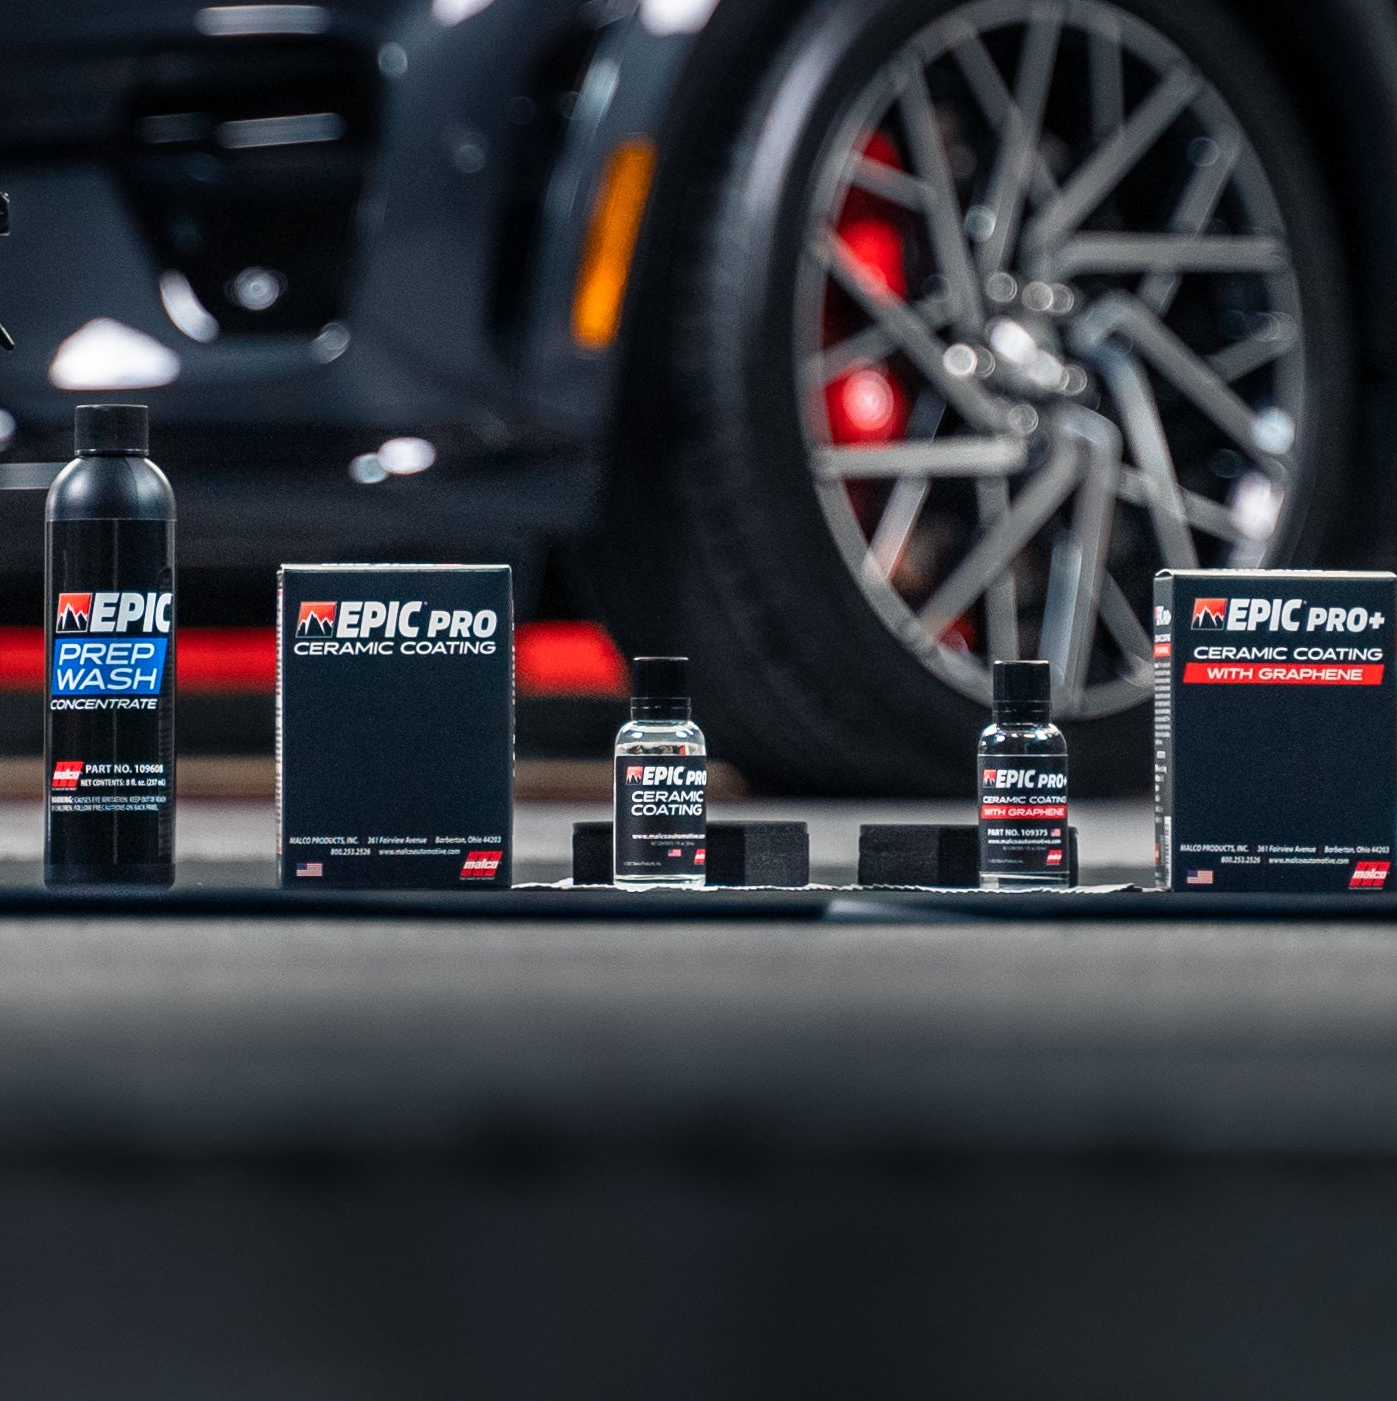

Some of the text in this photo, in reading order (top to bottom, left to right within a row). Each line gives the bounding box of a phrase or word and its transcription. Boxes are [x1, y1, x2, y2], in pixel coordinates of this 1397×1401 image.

[90, 593, 171, 632] EPIC
[1227, 598, 1385, 632] EPIC PRO+
[336, 601, 497, 638] EPIC PRO
[59, 643, 154, 665] PREP
[294, 642, 496, 655] CERAMIC COATING
[1194, 647, 1383, 661] CERAMIC COATING
[57, 668, 157, 690] WASH
[1207, 668, 1363, 680] WITH GRAPHENE
[50, 699, 157, 710] CONCENTRATE
[86, 765, 111, 773] PART
[114, 765, 132, 773] NO.
[643, 766, 707, 785] EPIC PRO
[996, 770, 1036, 788] EPIC
[632, 791, 704, 802] CERAMIC
[983, 796, 1066, 804] CERAMIC COATING
[631, 804, 702, 816] COATING
[984, 808, 1064, 816] WITH GRAPHENE
[463, 859, 499, 869] malco
[1352, 869, 1387, 879] malco
